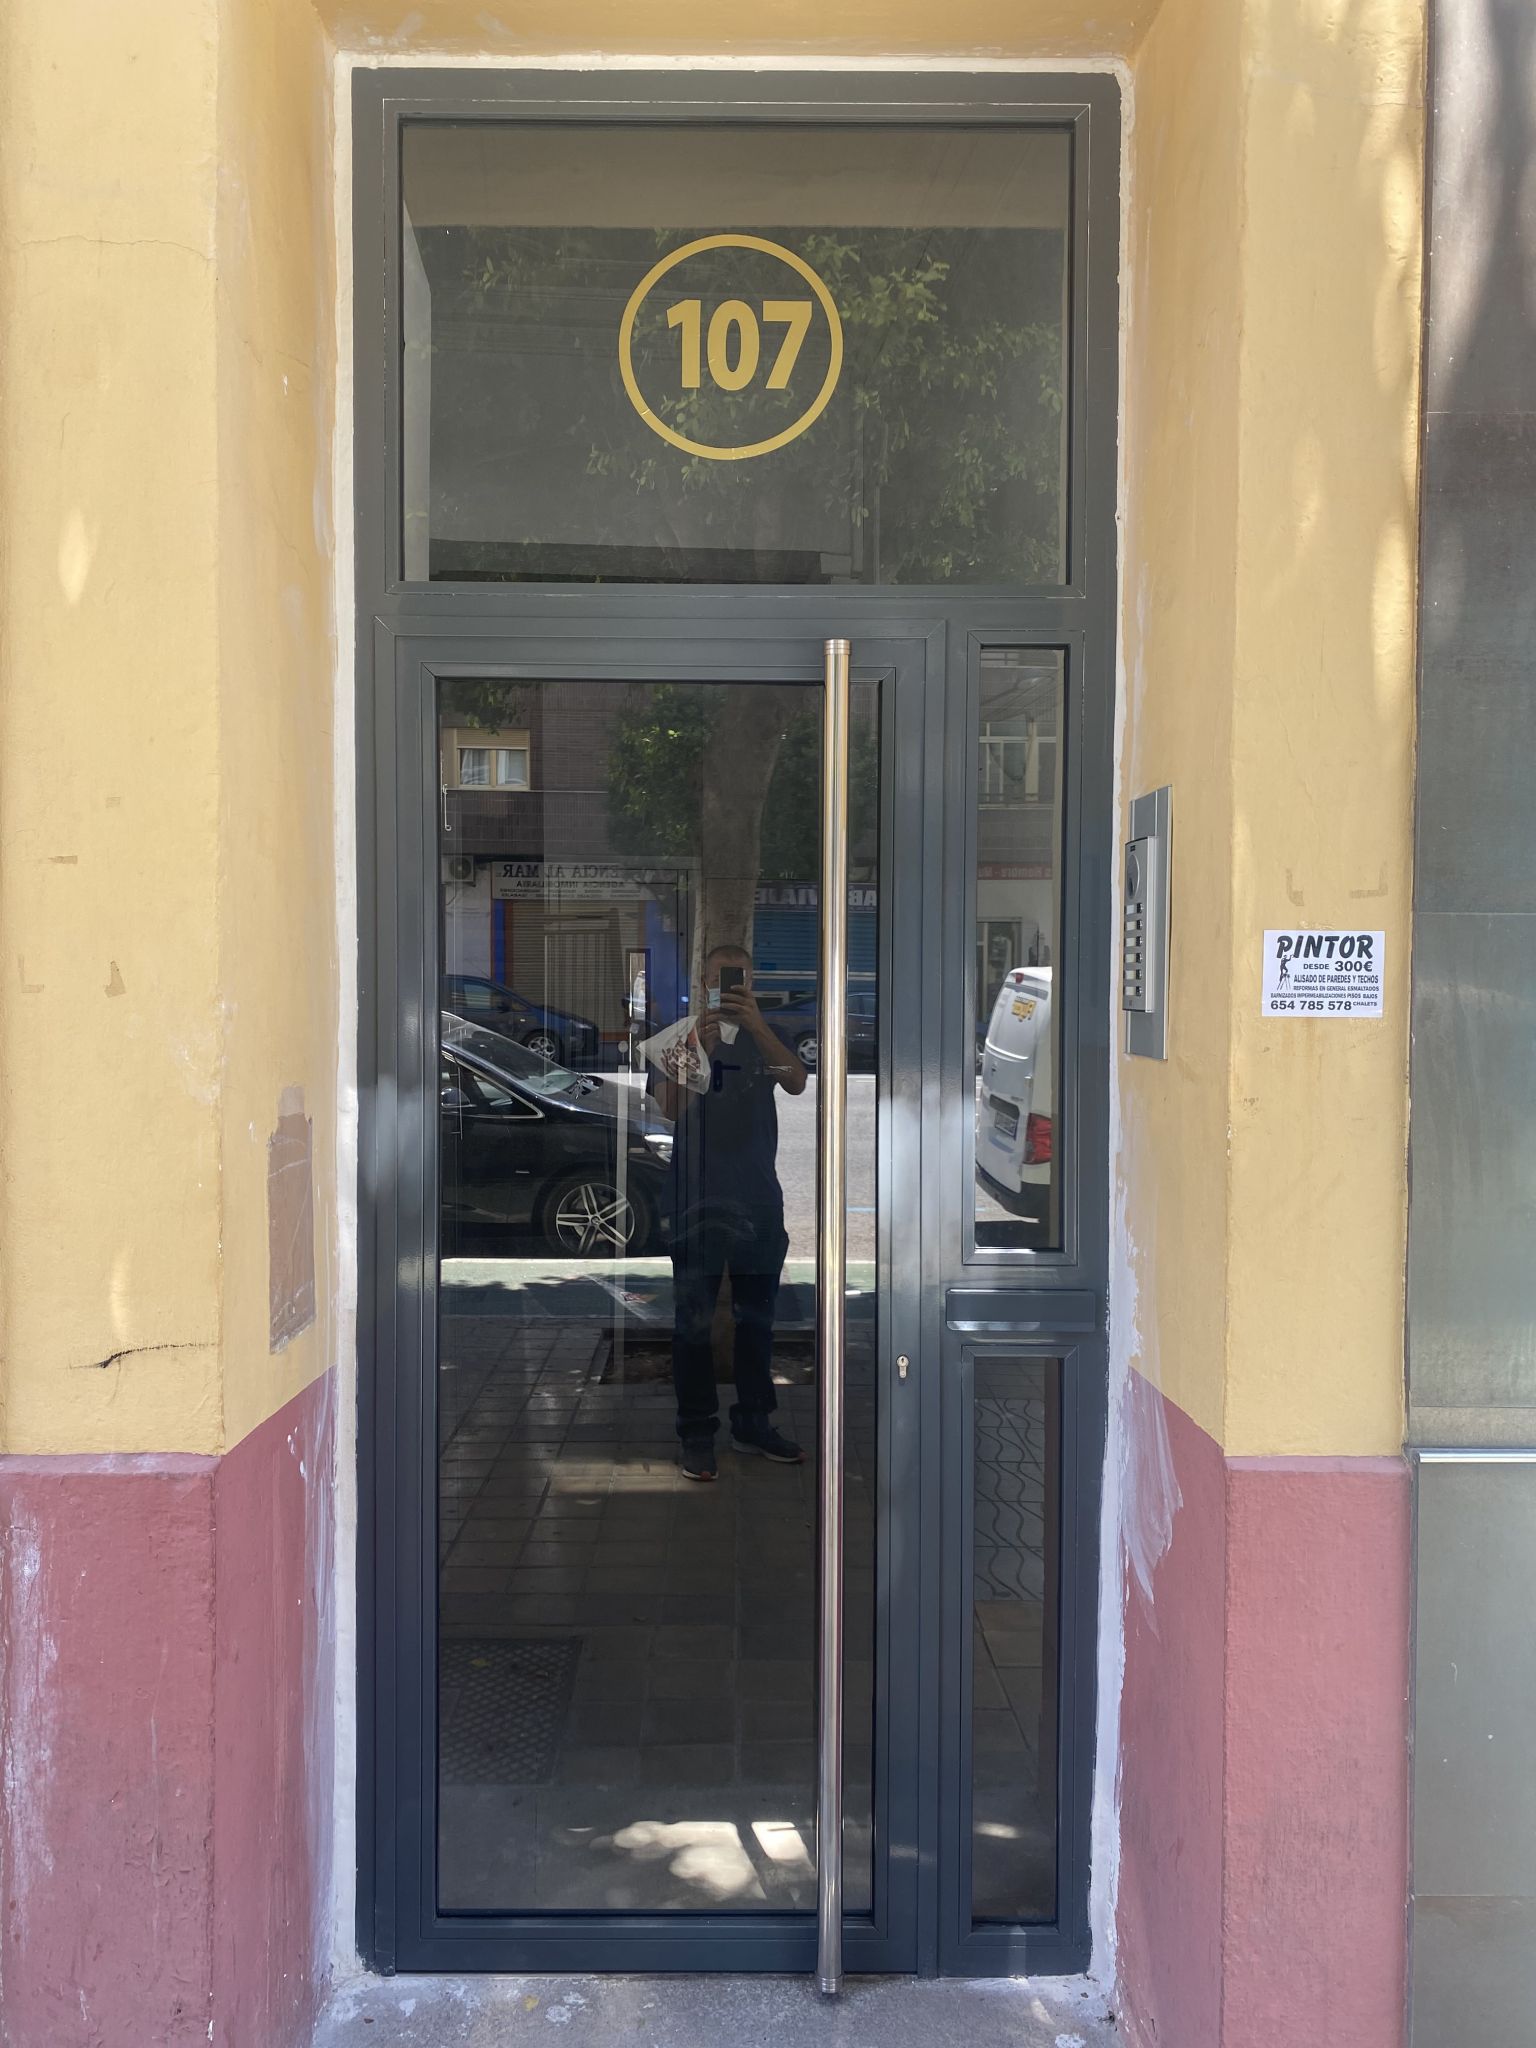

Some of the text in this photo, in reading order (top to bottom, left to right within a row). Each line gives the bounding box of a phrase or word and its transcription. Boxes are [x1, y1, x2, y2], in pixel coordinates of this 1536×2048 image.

[666, 299, 812, 391] 107
[1276, 935, 1373, 959] PINTOR
[1334, 960, 1373, 972] 300€
[1293, 974, 1379, 984] ALISADO DE PAREDES Y TECHOS
[1270, 1000, 1352, 1011] 654 785 578
